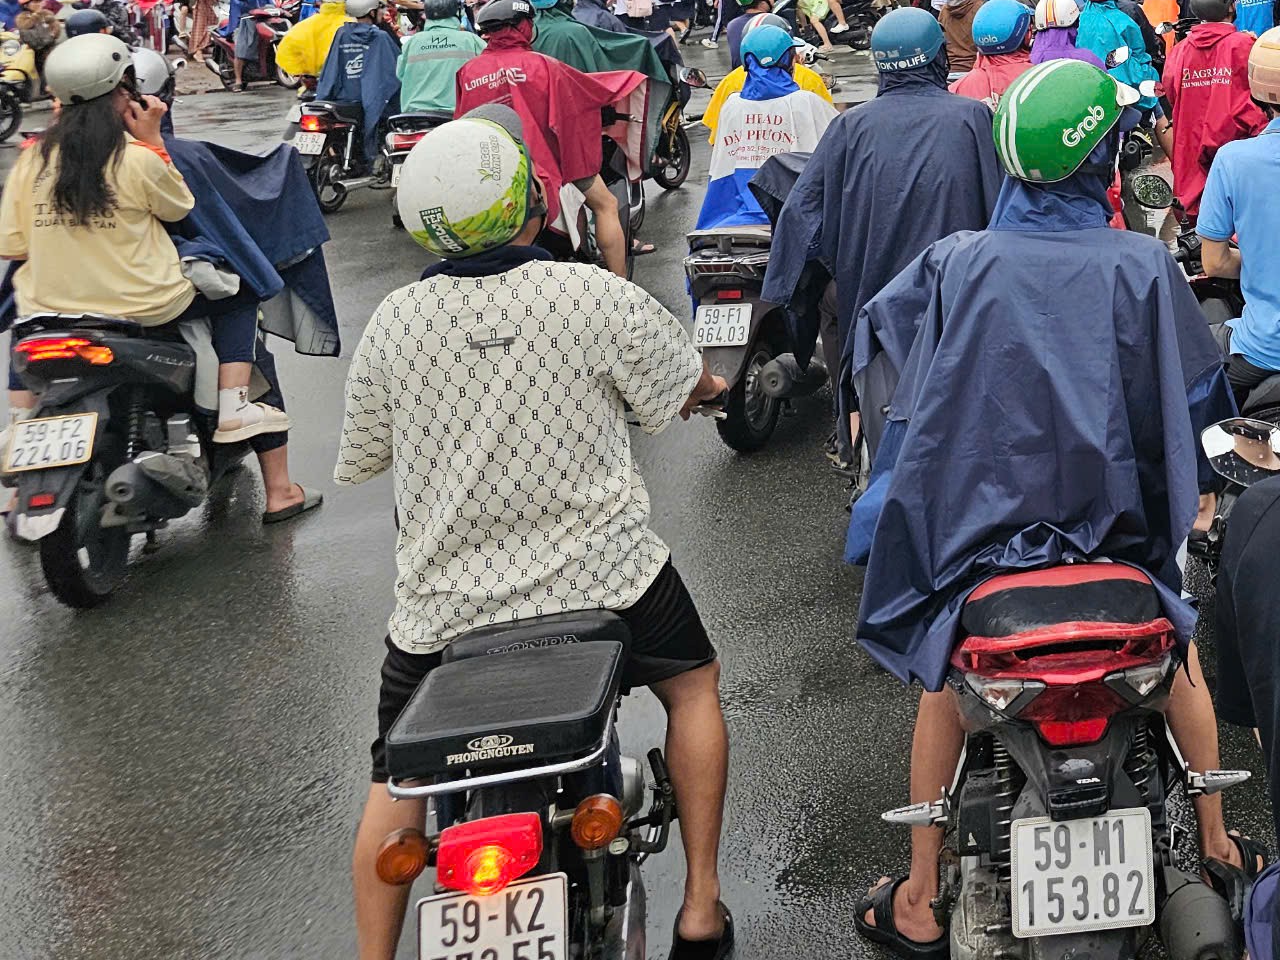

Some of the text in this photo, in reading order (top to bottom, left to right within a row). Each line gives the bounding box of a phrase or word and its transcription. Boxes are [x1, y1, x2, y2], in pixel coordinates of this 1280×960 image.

[745, 114, 783, 126] HEAD
[1062, 105, 1105, 147] Grab
[704, 307, 742, 325] 59-F1
[697, 326, 745, 344] 964.03
[24, 418, 83, 444] 59-F2
[12, 440, 86, 468] 224.06
[446, 743, 535, 766] PHONGNGUYEN
[1034, 818, 1126, 872] 59-M1
[1022, 870, 1145, 927] 153.82
[440, 887, 546, 947] 59-K2
